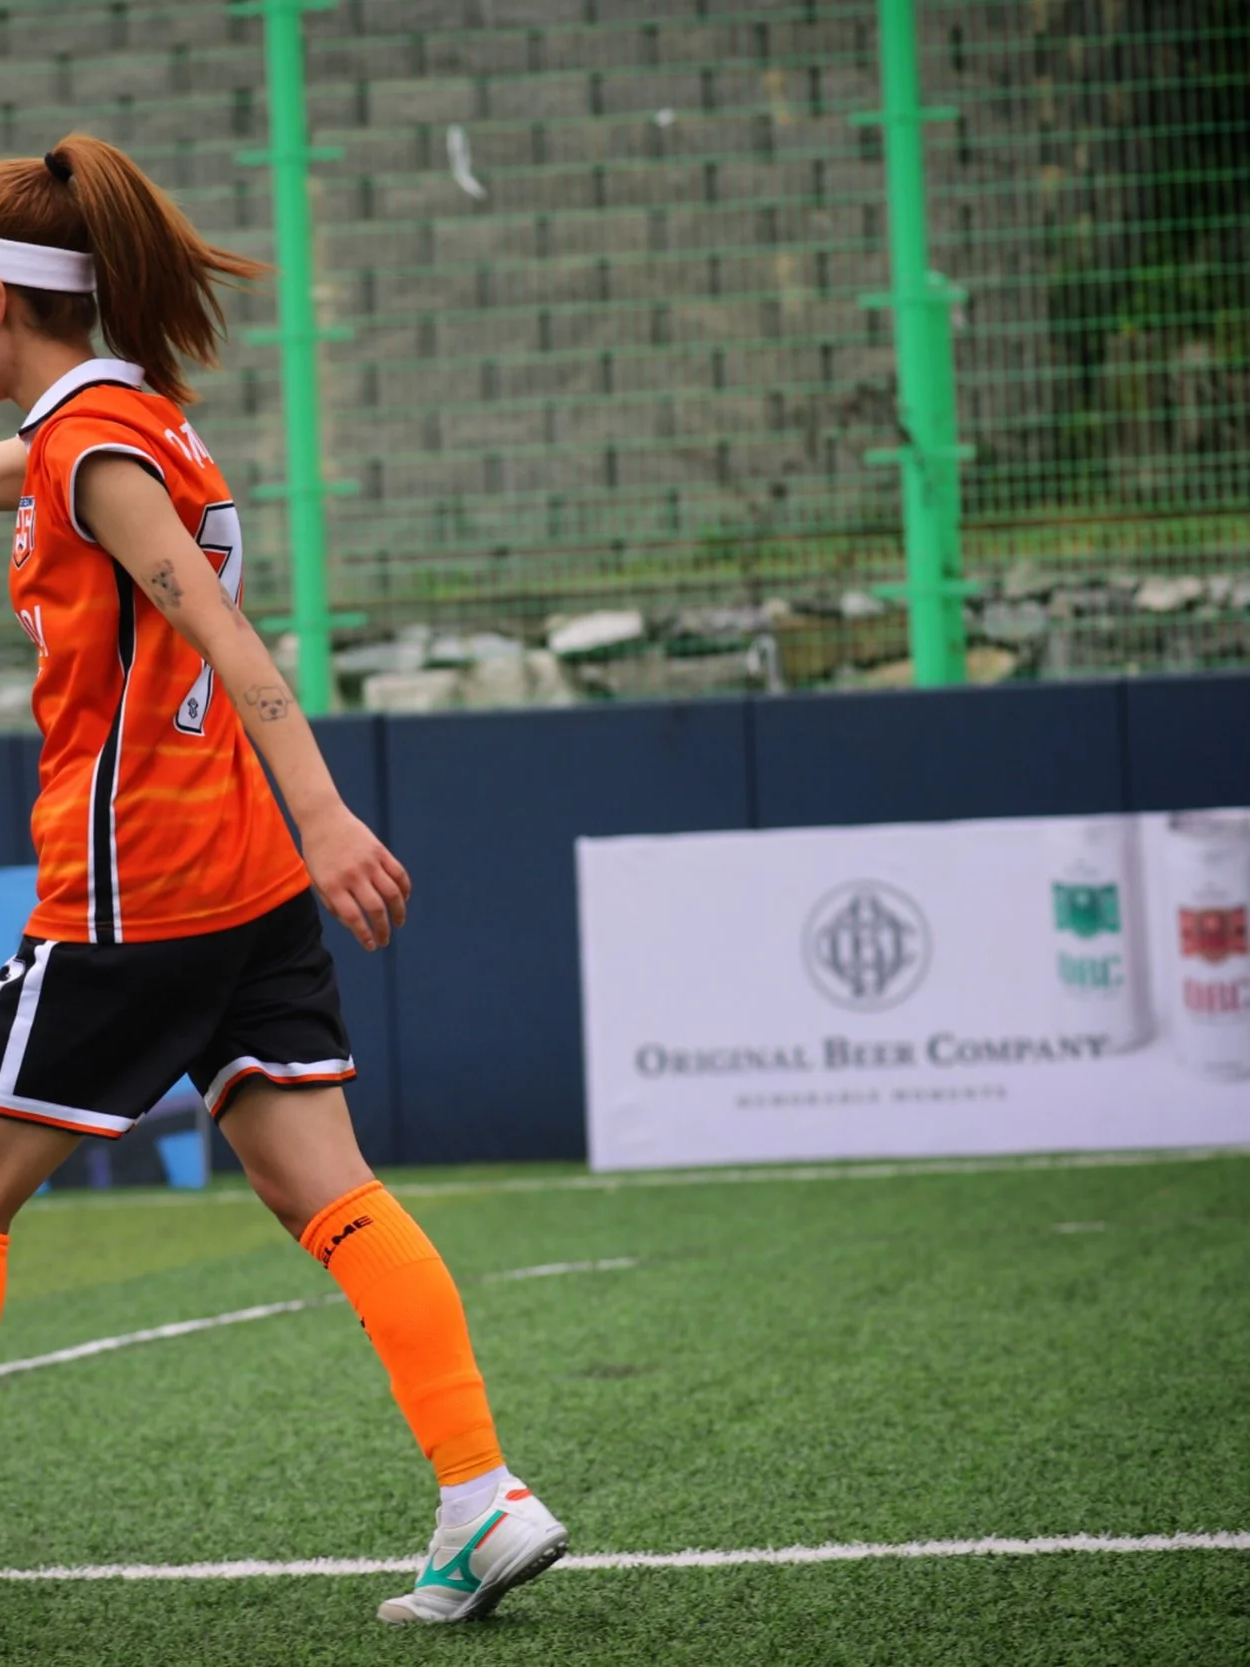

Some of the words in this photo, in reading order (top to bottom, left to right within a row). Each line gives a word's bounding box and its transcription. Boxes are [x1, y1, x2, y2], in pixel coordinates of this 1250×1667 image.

[634, 1042, 812, 1080] ORIGINAL
[822, 1034, 916, 1070] BEER
[924, 1030, 1111, 1069] COMPANY
[321, 1214, 374, 1270] ELME
